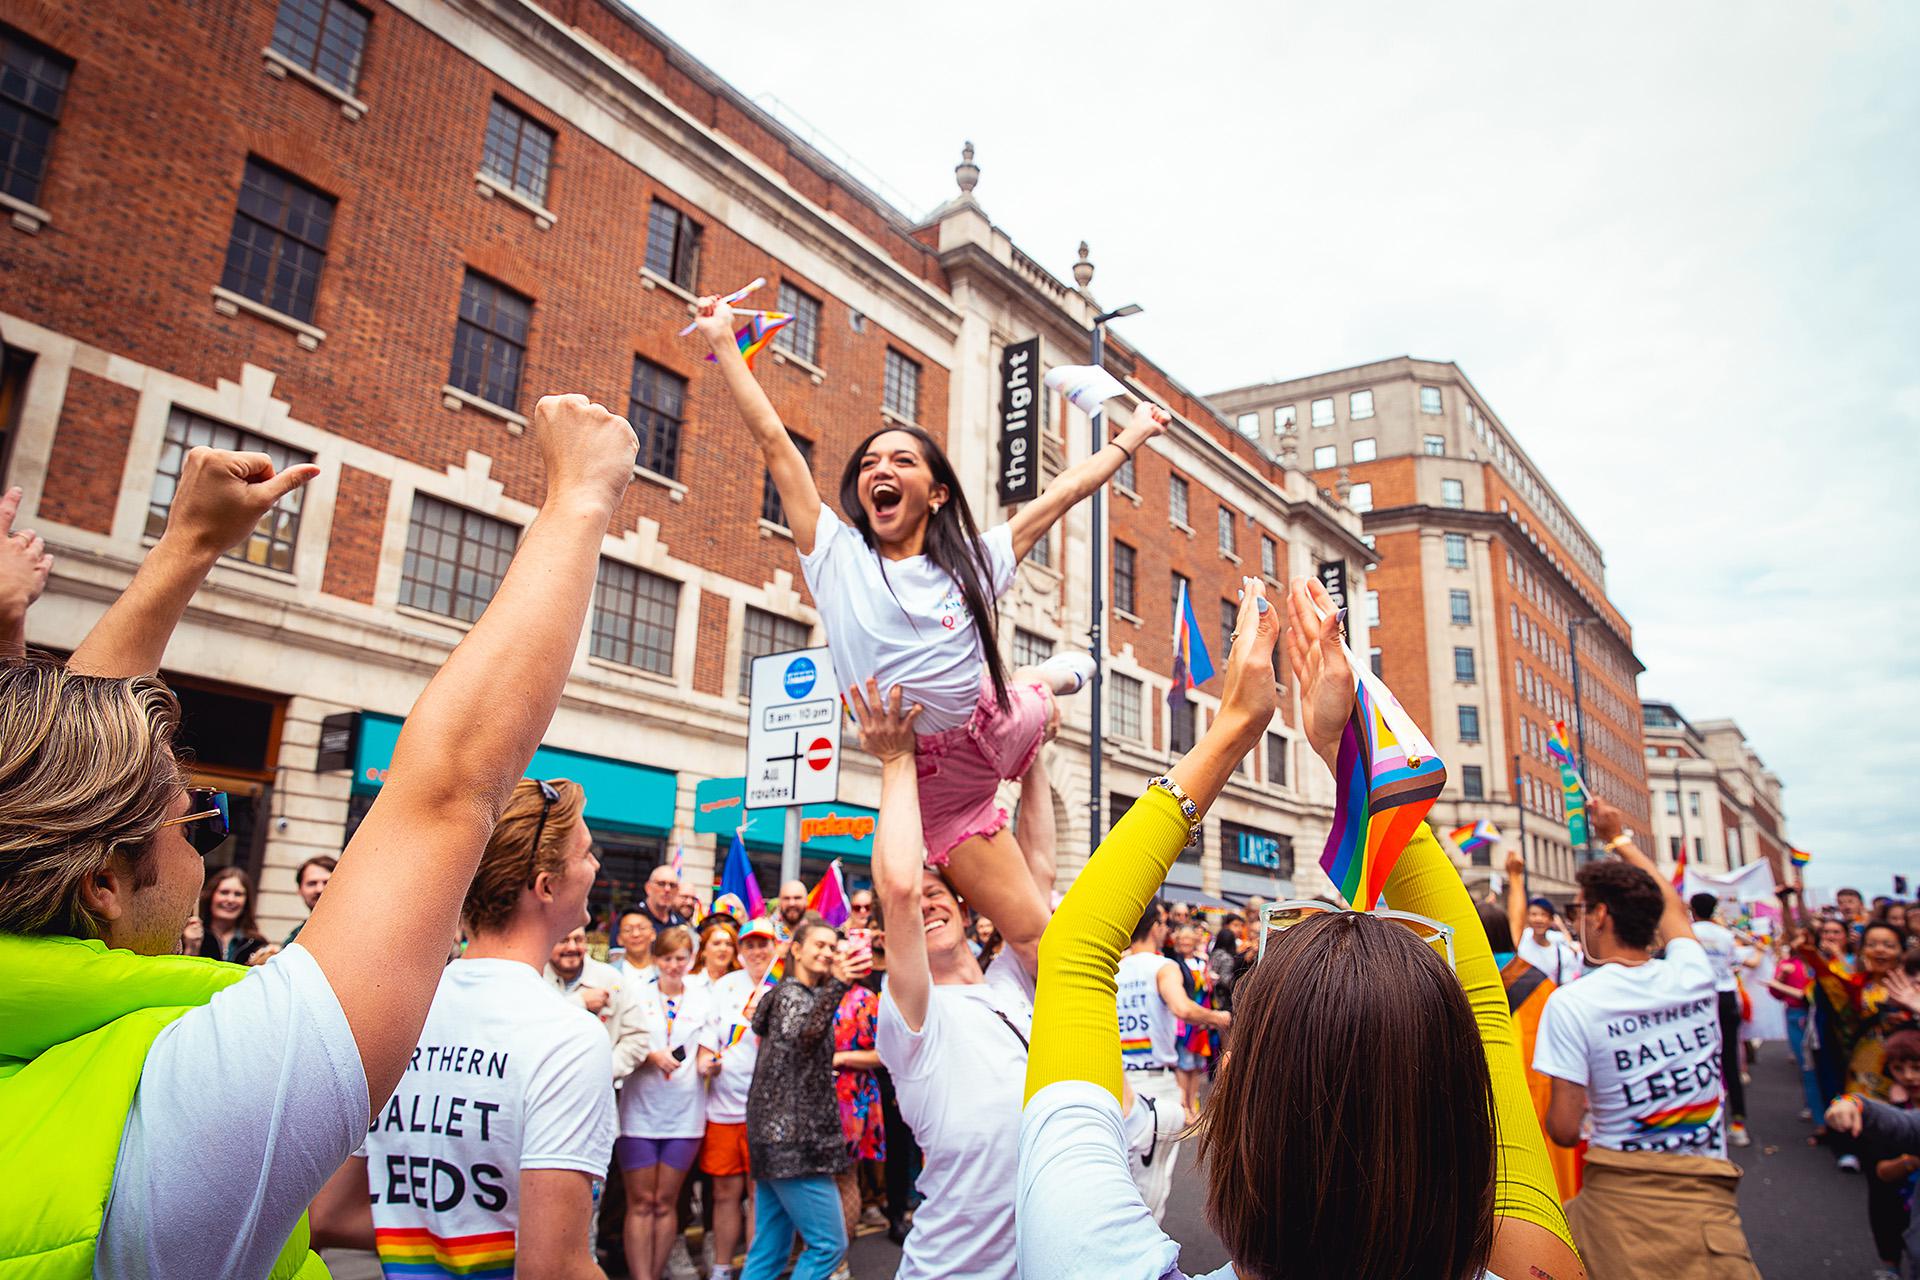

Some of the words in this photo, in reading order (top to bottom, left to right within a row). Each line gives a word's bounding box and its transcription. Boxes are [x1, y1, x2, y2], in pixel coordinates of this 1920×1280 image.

[1006, 350, 1032, 432] light
[1005, 437, 1027, 490] the
[762, 768, 779, 781] All
[750, 787, 789, 799] routes
[1118, 1013, 1150, 1033] EDS
[405, 1045, 509, 1079] RTHERN
[368, 1094, 500, 1142] ALLET
